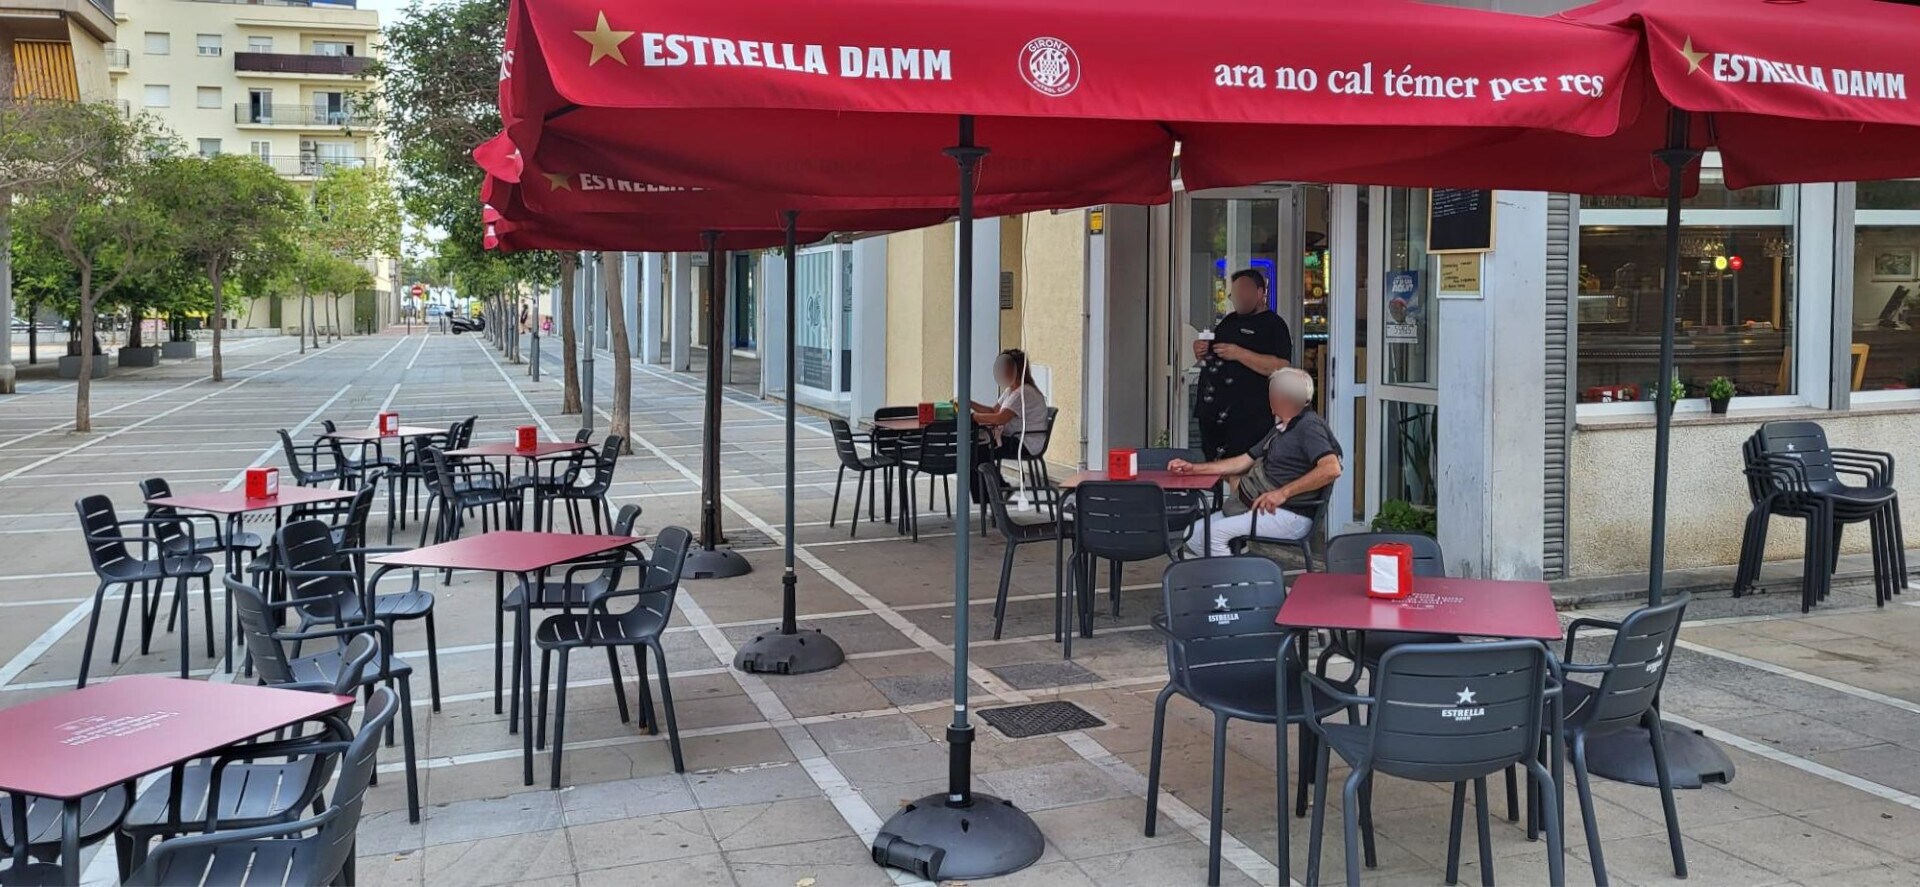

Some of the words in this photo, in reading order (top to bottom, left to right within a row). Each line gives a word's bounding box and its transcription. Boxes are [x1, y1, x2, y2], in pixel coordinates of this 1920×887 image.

[641, 32, 829, 75] ESTRELLA
[838, 45, 952, 80] DAMM
[1028, 39, 1069, 56] GIRONA
[1214, 63, 1267, 88] ara
[1275, 66, 1318, 91] no
[1327, 62, 1374, 94] cal
[1383, 64, 1479, 98] témer
[1489, 75, 1547, 101] per
[1557, 73, 1604, 97] res
[1712, 53, 1829, 92] ESTRELLA
[1832, 69, 1907, 99] DAMM
[1441, 708, 1485, 717] ESTRELLA
